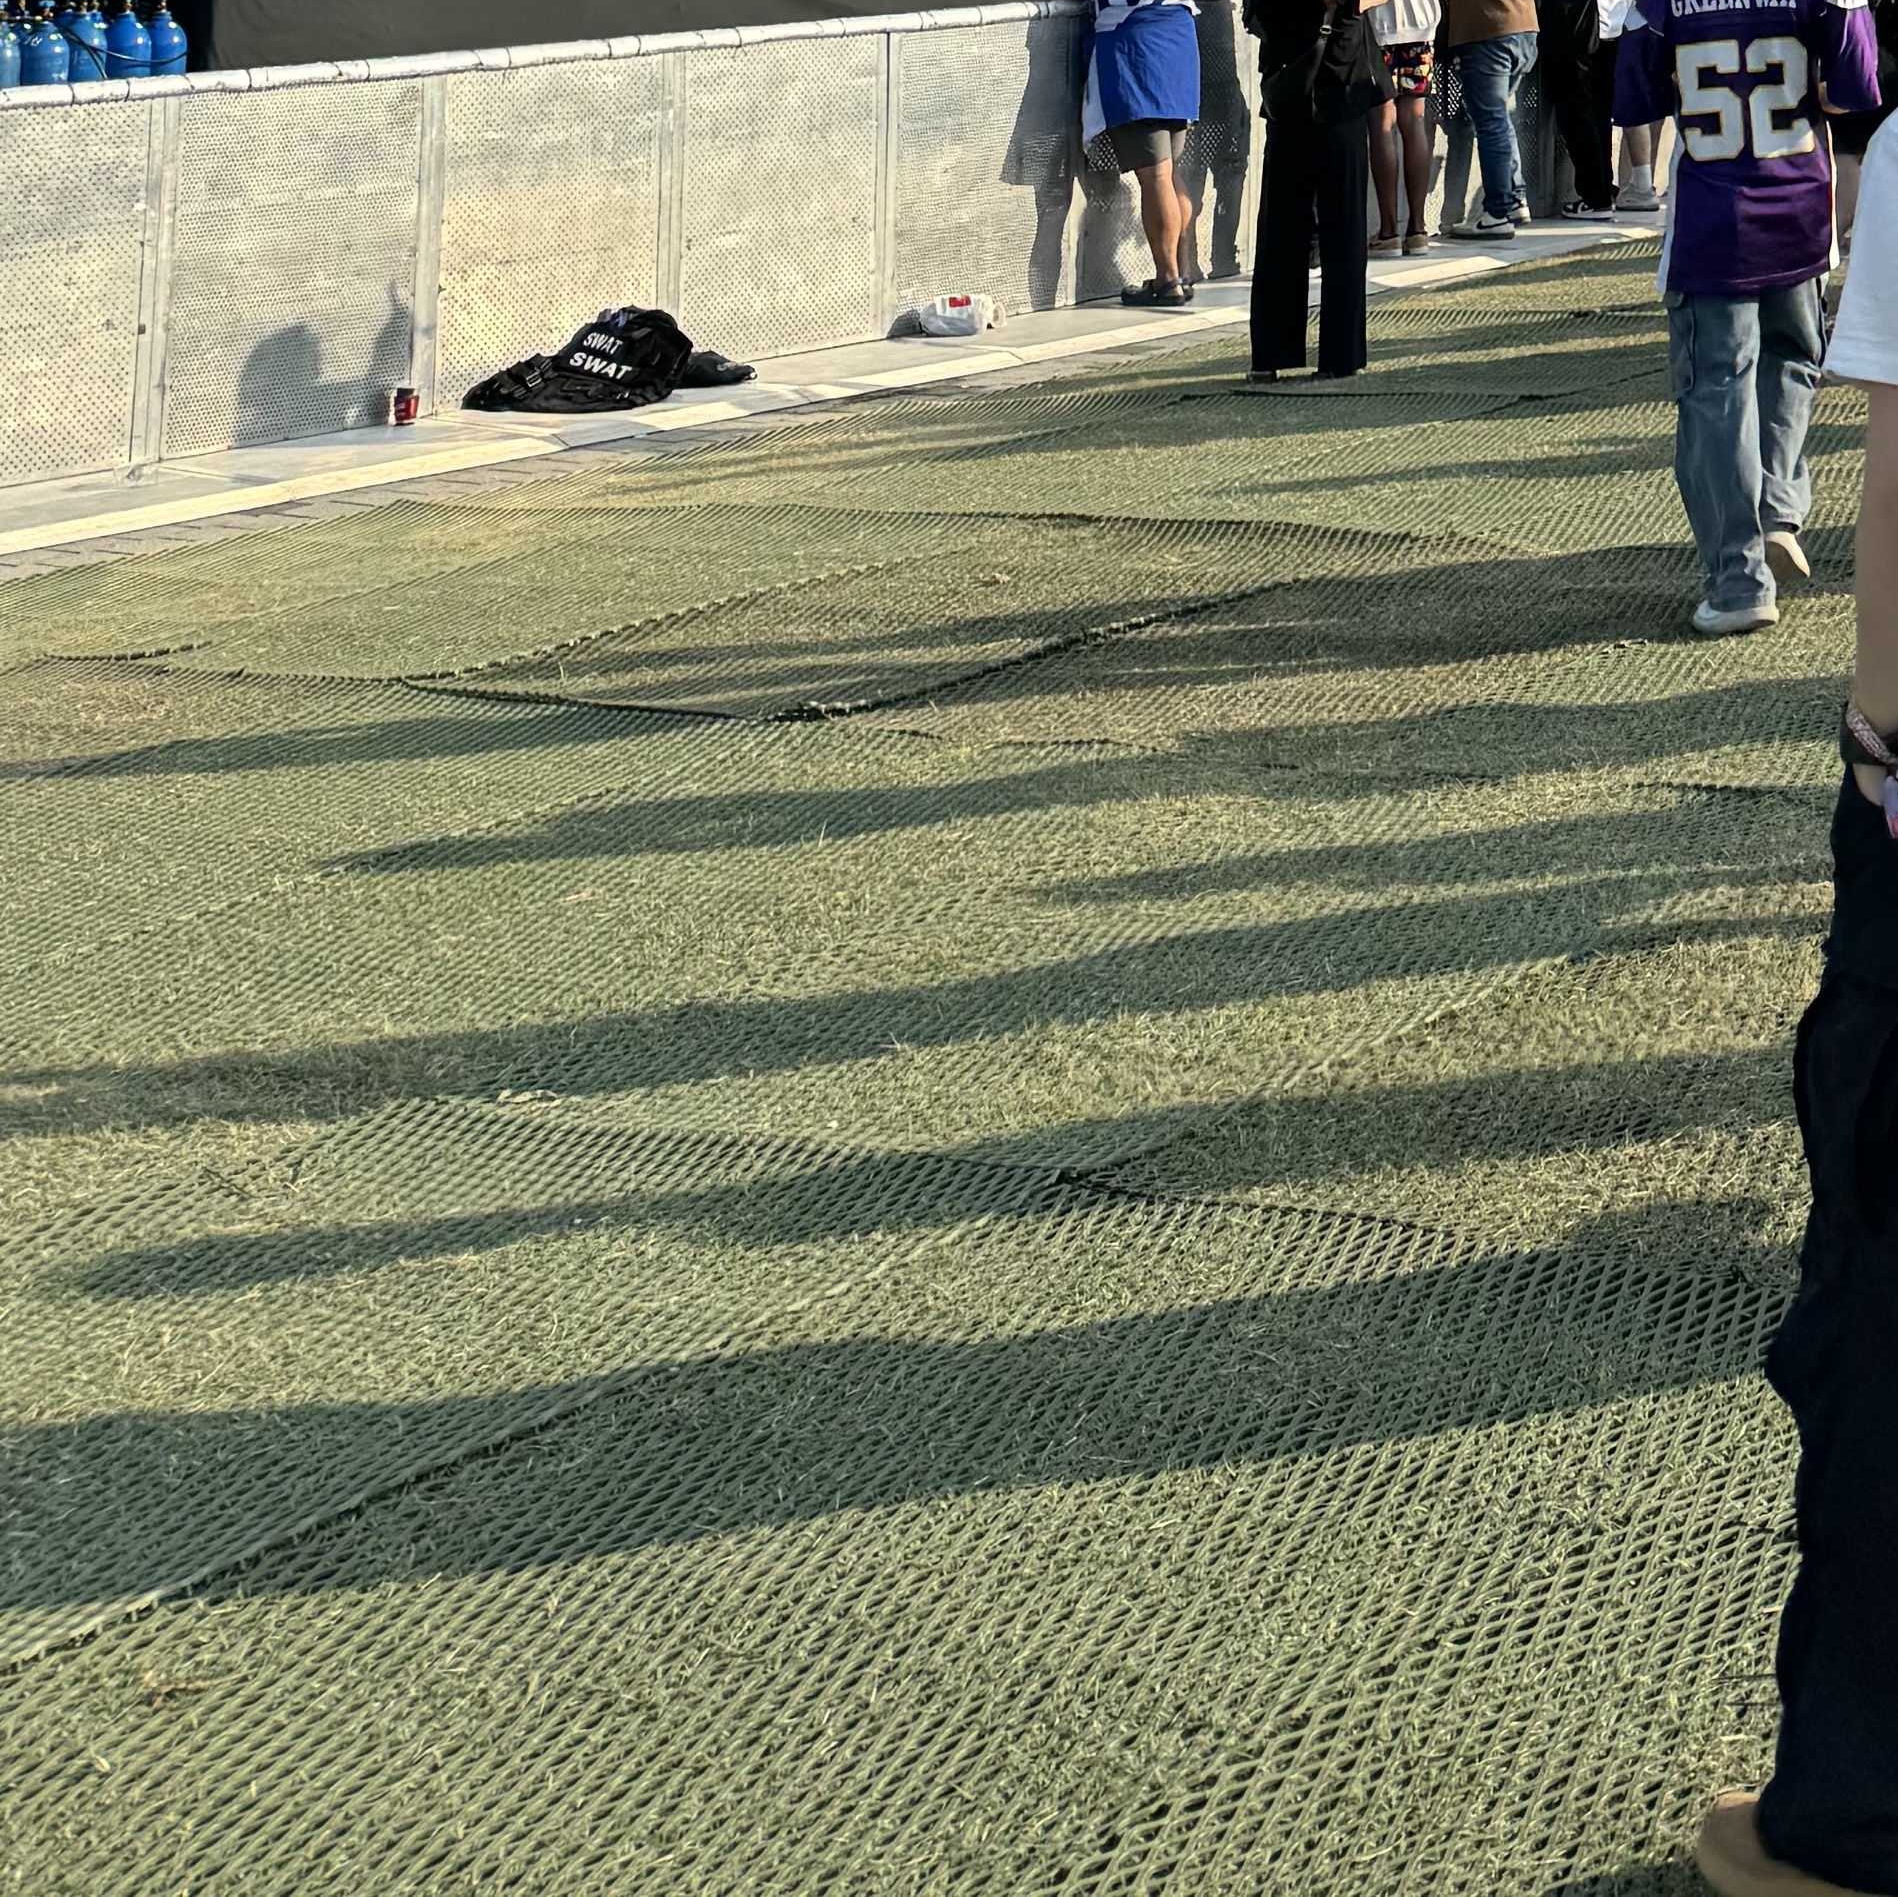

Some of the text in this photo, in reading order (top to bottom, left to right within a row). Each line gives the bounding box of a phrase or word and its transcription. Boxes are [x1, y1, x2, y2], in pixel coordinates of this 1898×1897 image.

[1675, 36, 1815, 162] 52
[583, 332, 623, 354] SWAT
[569, 352, 633, 379] SWAT
